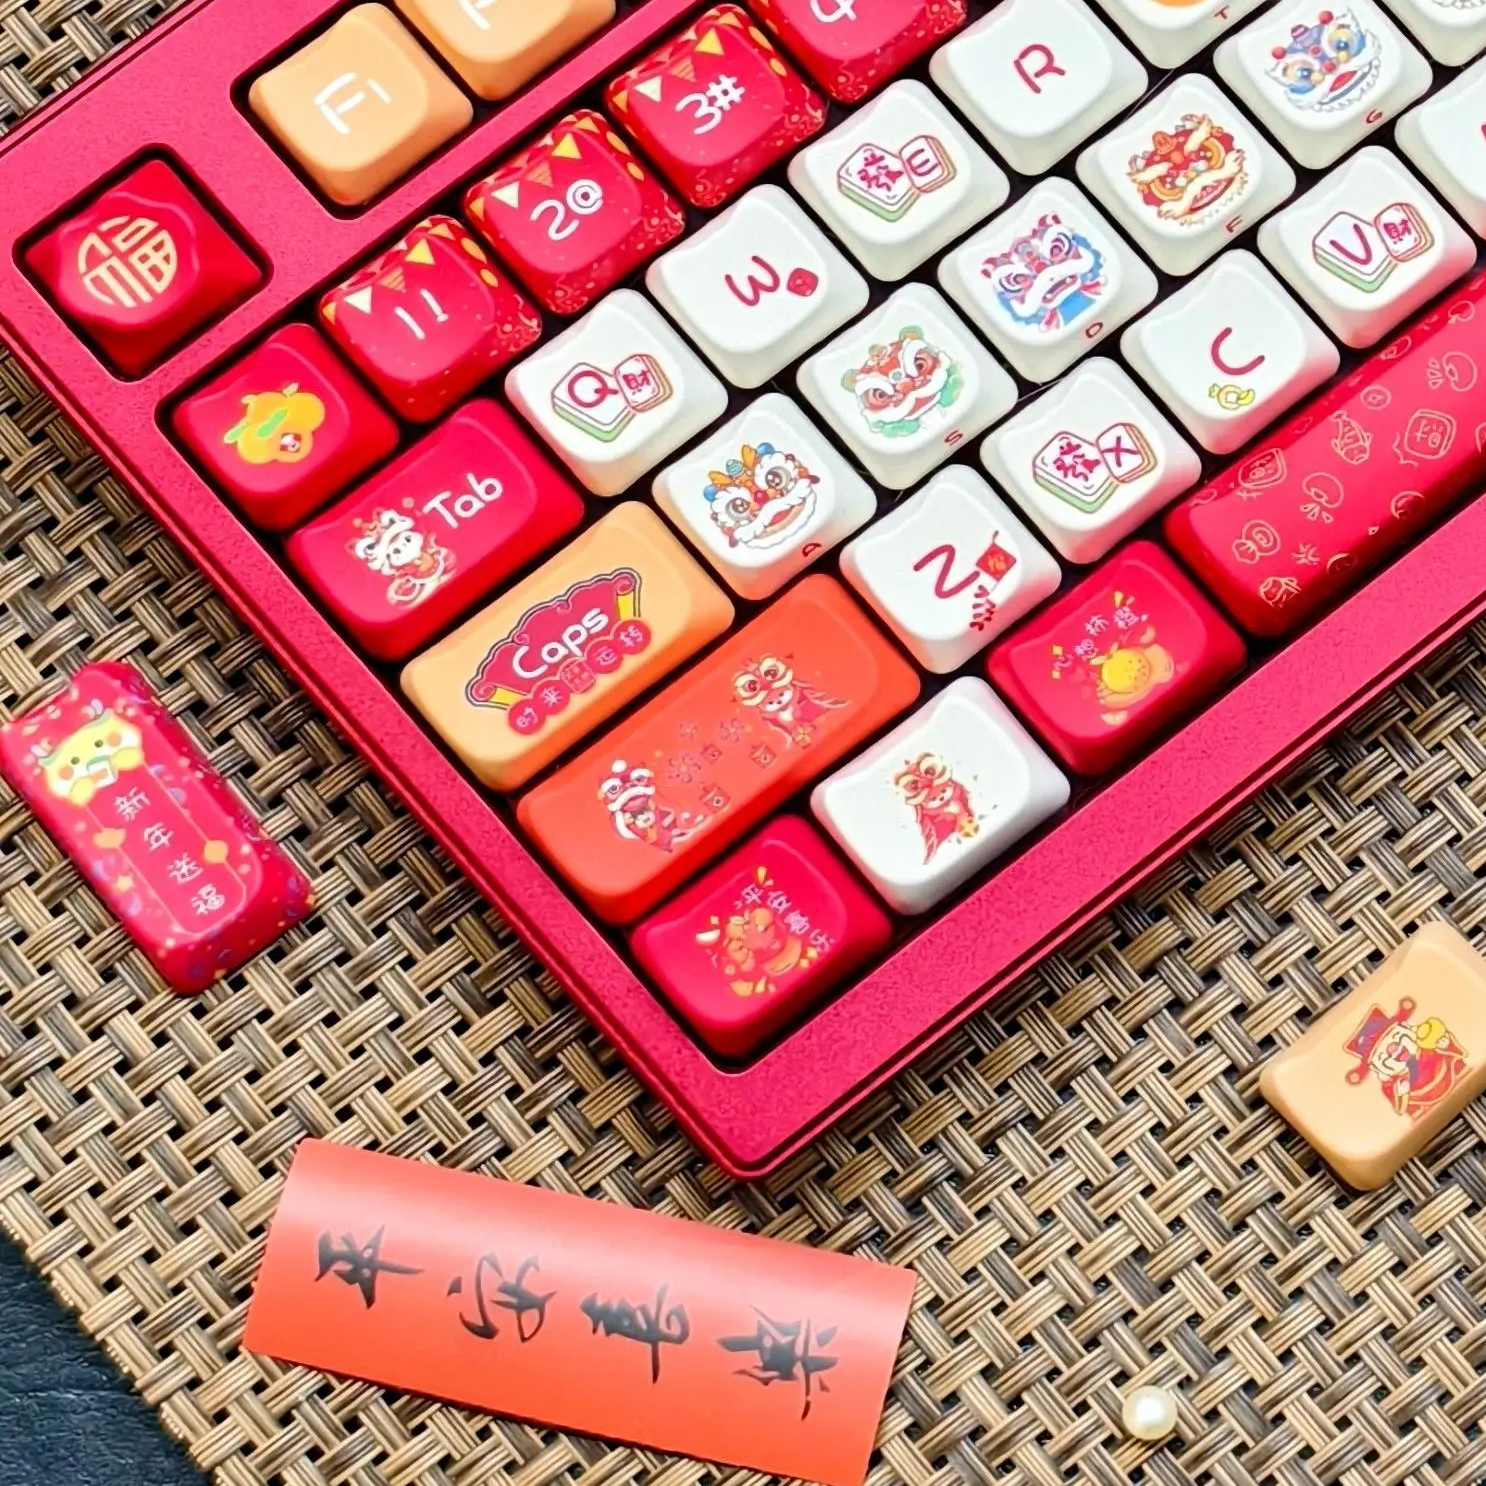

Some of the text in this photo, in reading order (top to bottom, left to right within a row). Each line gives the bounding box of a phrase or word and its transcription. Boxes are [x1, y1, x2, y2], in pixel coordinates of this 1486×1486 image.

[1014, 44, 1065, 93] R
[313, 72, 391, 136] F1
[677, 76, 743, 133] 3#
[909, 149, 939, 177] E
[531, 180, 601, 240] 2@
[1330, 222, 1373, 265] V
[1211, 328, 1265, 375] C
[568, 369, 619, 408] Q
[1106, 444, 1139, 469] X
[423, 473, 503, 531] Tab
[914, 545, 979, 598] Z
[513, 608, 609, 678] Caps
